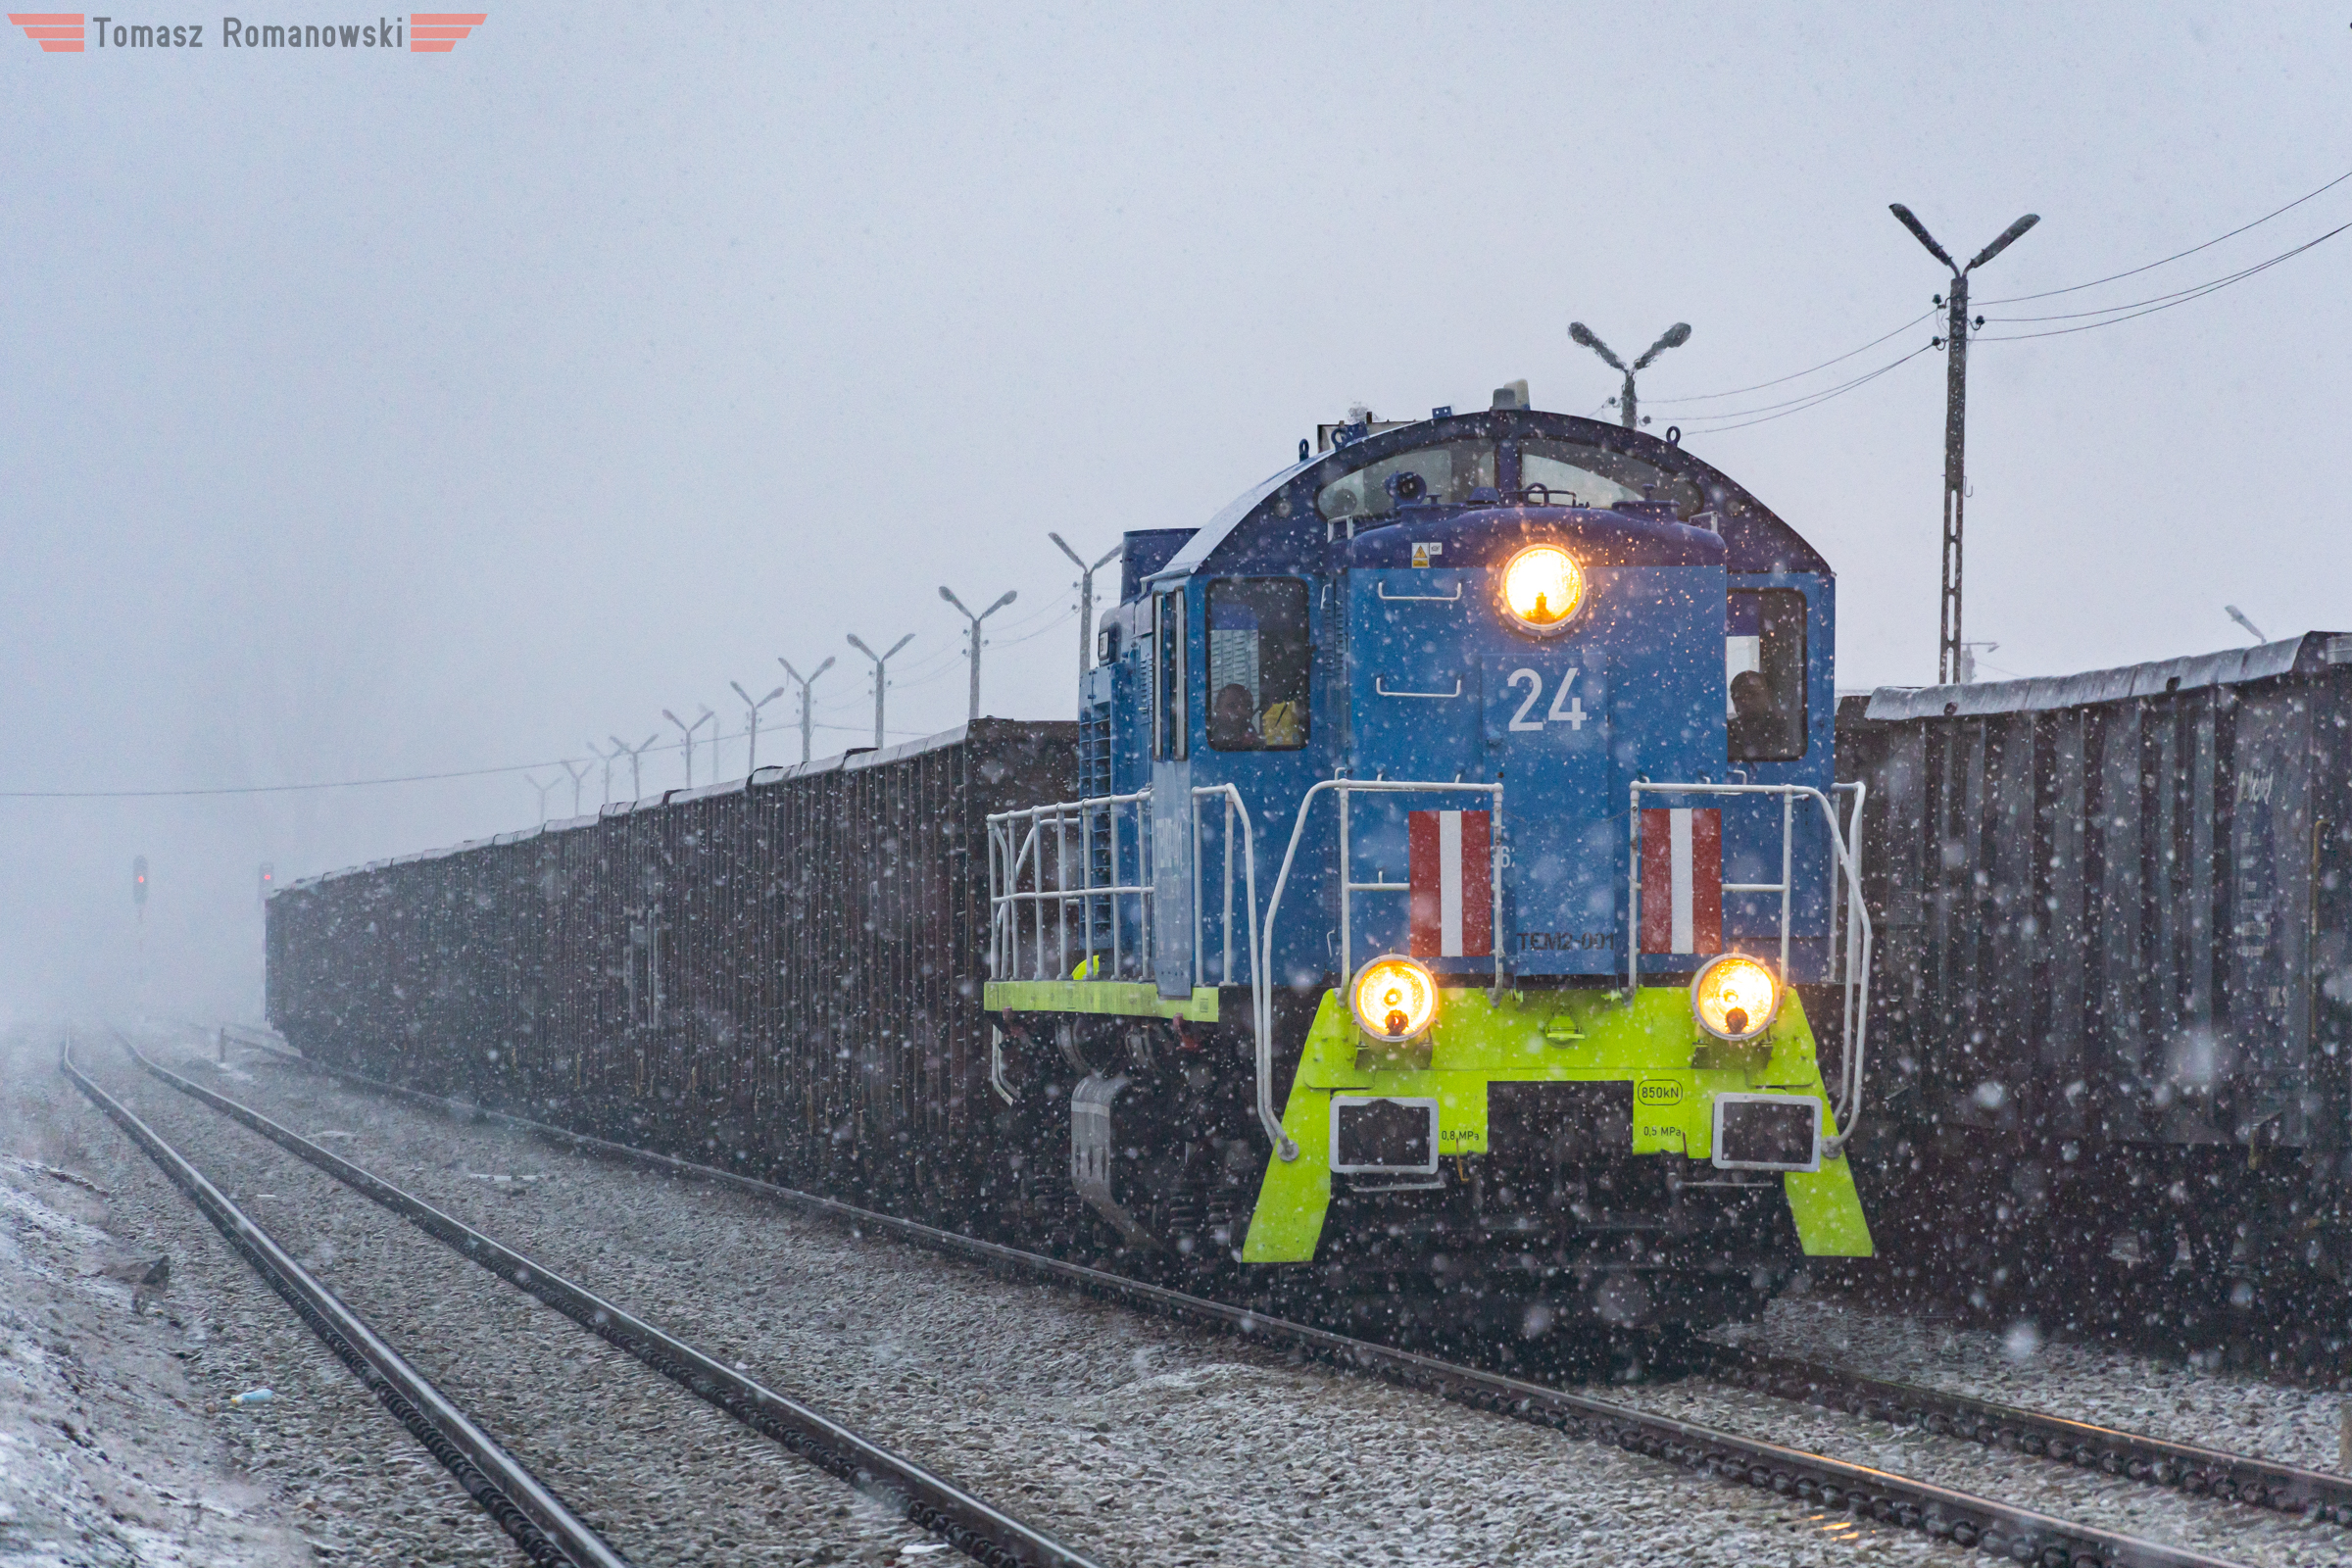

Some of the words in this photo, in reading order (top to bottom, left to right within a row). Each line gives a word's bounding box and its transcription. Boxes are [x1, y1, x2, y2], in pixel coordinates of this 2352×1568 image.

[1508, 667, 1587, 731] 24
[1516, 932, 1614, 951] TEM2-001
[1642, 1087, 1679, 1098] 850kN
[1441, 1130, 1455, 1141] 0,8
[1458, 1130, 1480, 1141] MPa
[1661, 1127, 1681, 1136] MPa
